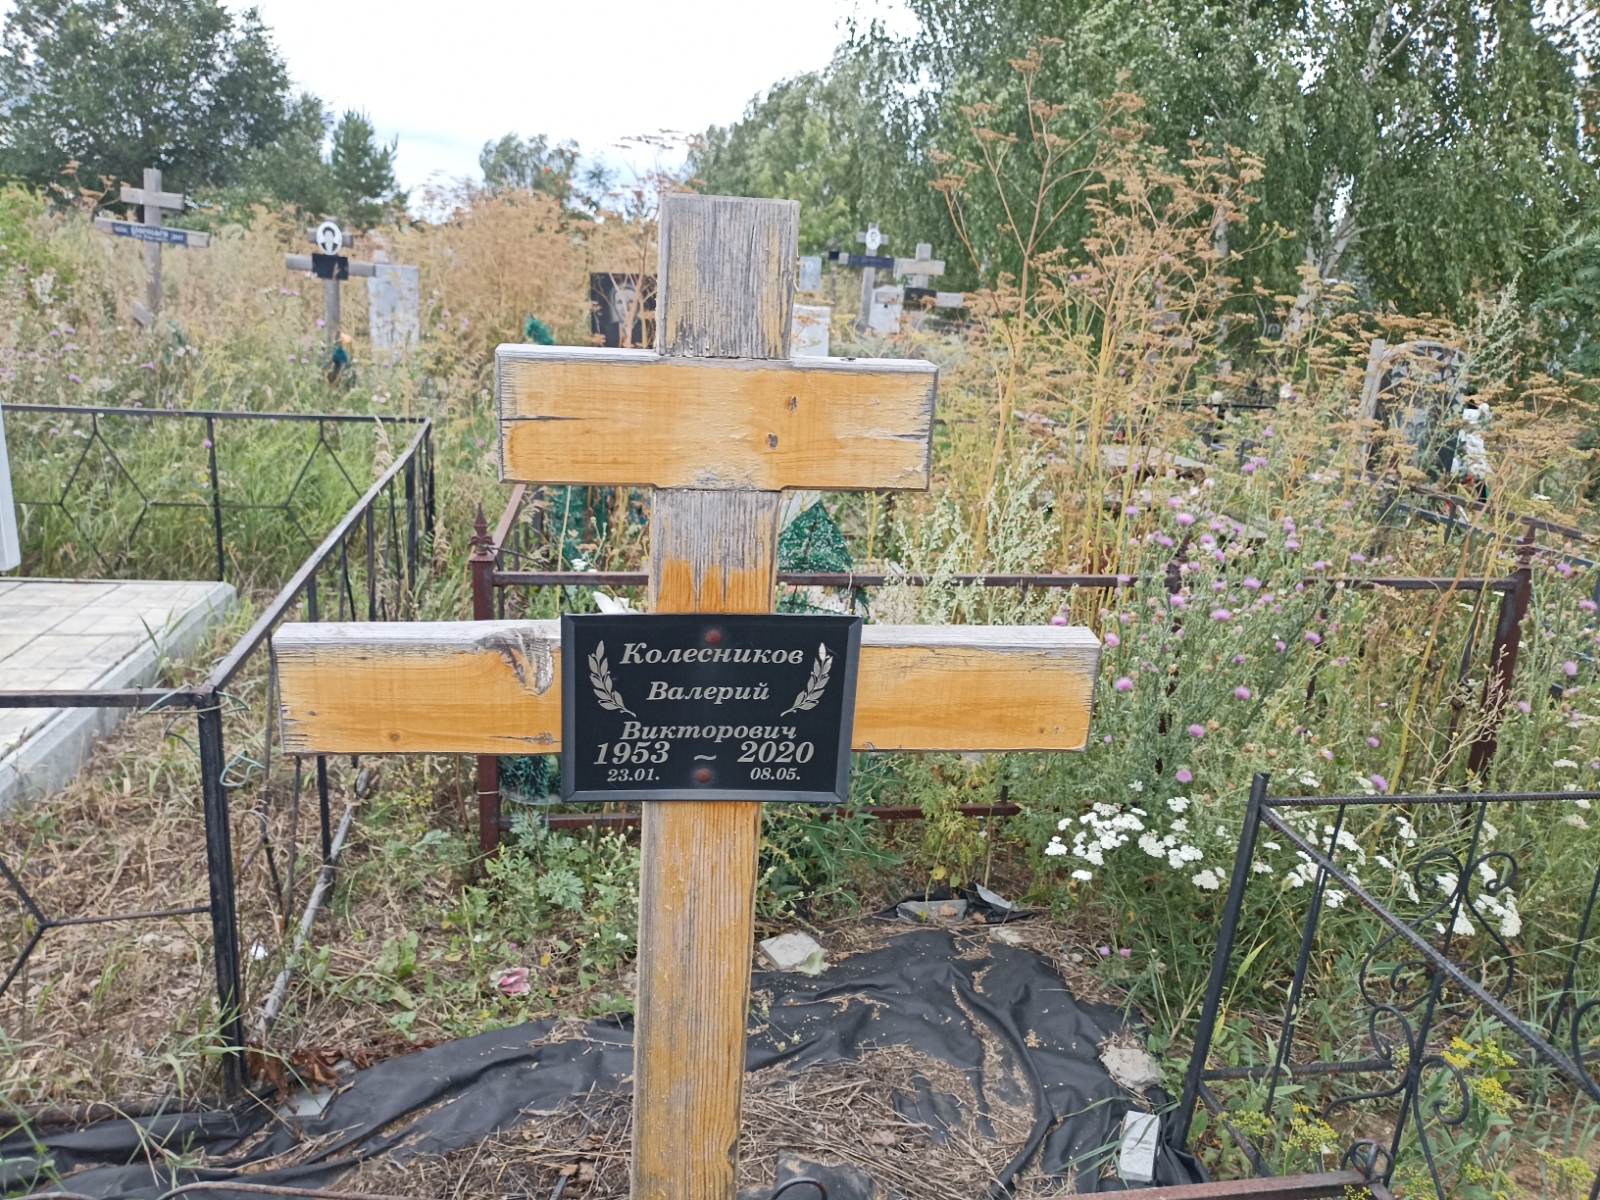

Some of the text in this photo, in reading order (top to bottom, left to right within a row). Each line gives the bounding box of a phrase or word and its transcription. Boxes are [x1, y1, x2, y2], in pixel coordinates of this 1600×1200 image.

[619, 642, 804, 665] Колесников
[645, 681, 770, 705] Валерий
[619, 721, 798, 743] Викторович
[593, 740, 671, 765] 1953
[736, 740, 815, 764] 2020
[606, 767, 801, 782] 23.01. 08.05.
